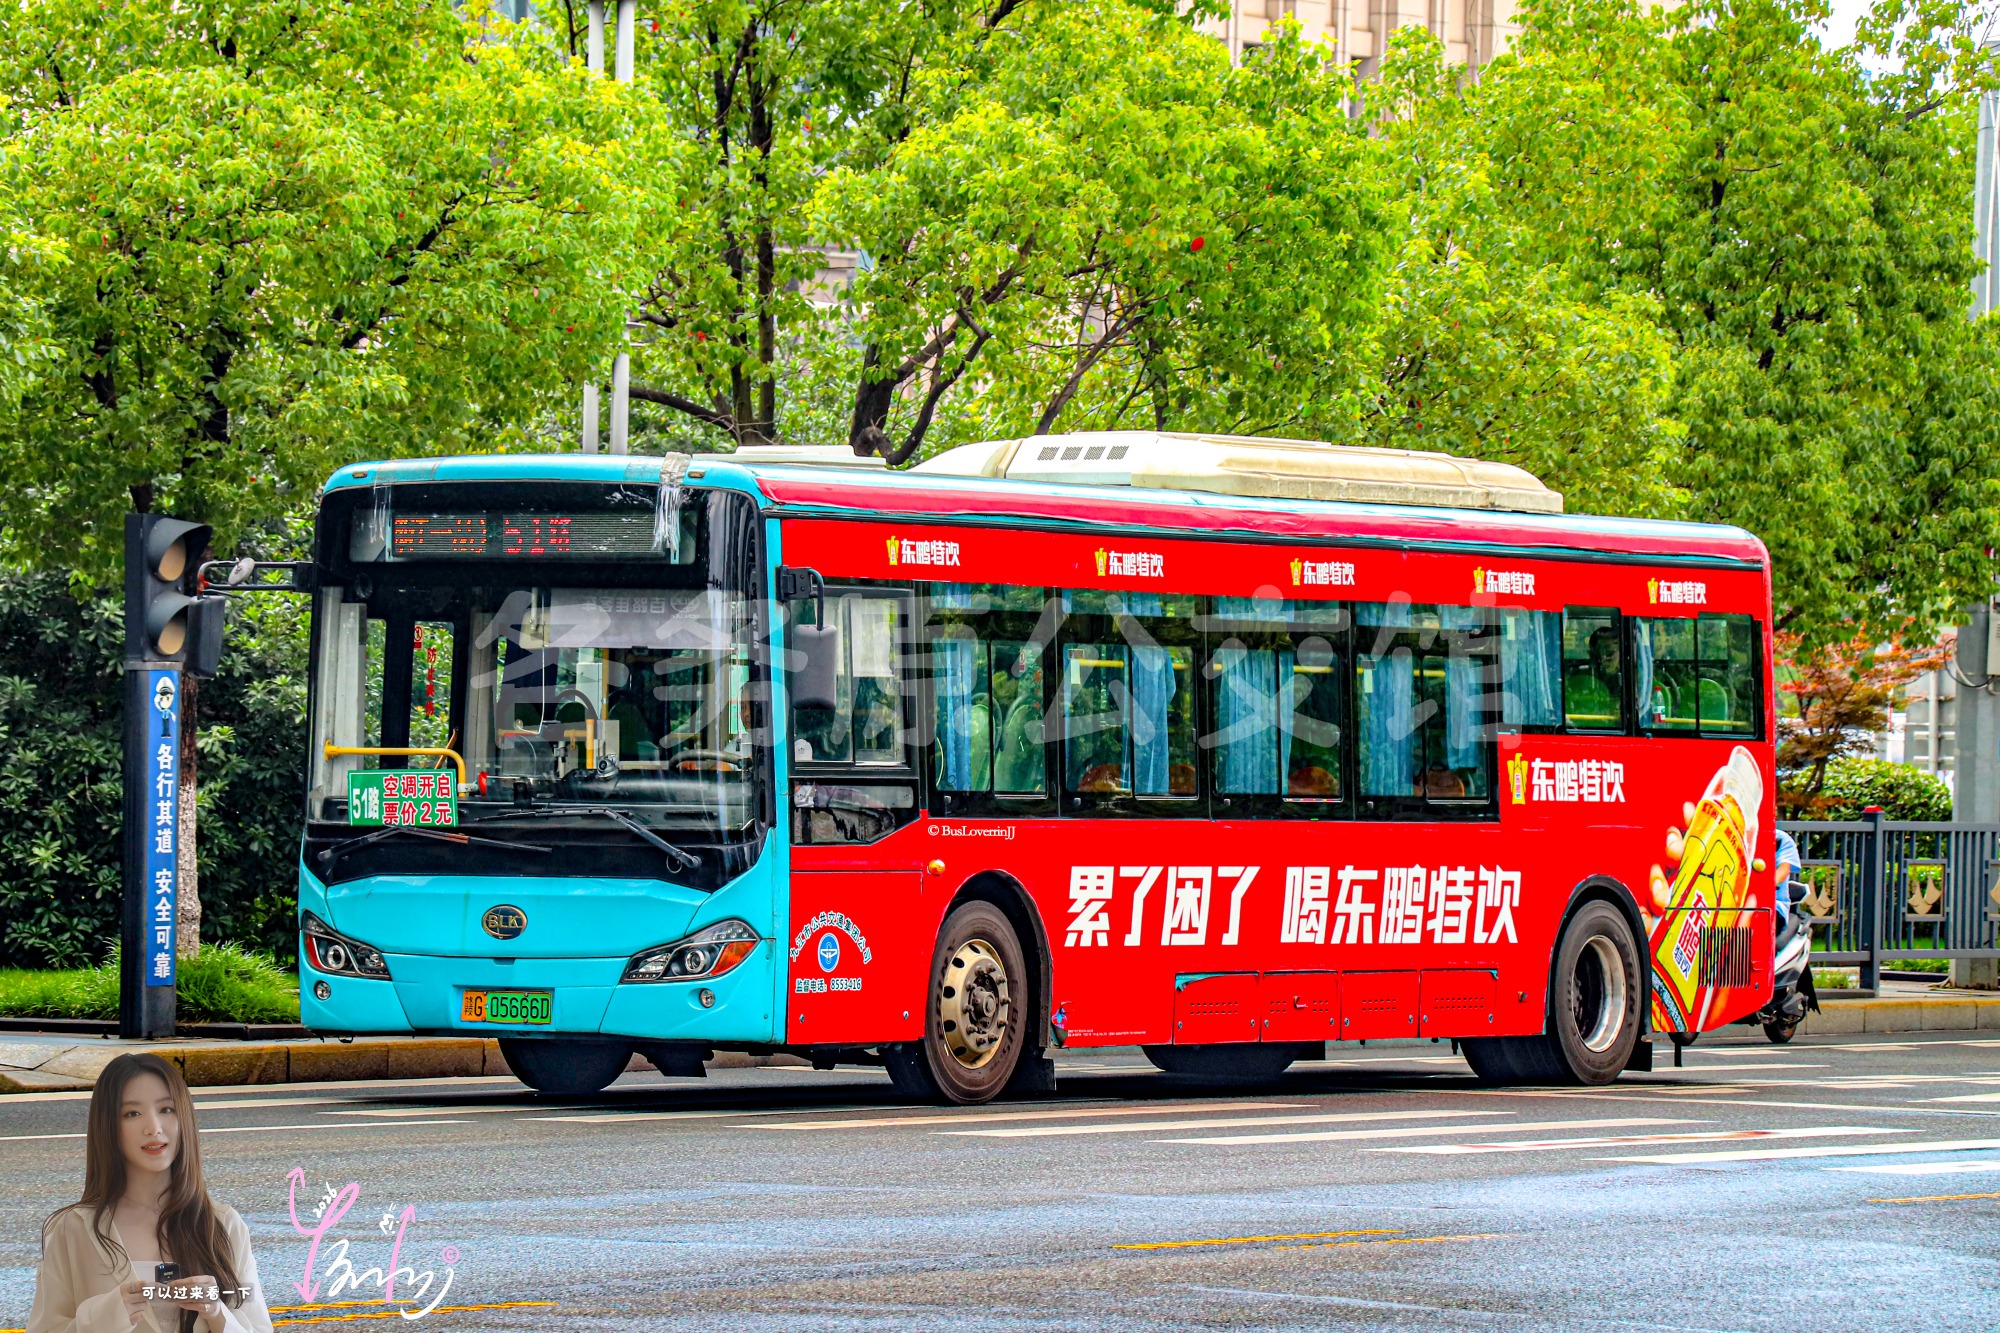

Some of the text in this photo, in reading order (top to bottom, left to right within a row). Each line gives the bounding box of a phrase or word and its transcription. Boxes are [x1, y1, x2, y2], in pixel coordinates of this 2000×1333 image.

[901, 538, 960, 566] 东鹏特饮
[1108, 551, 1164, 578] 东鹏特饮
[1303, 560, 1355, 586] 东鹏特饮
[1486, 569, 1536, 596] 东鹏特饮
[1659, 580, 1707, 604] 东鹏特饮
[383, 775, 451, 798] 空调开启
[1531, 757, 1626, 802] 东鹏特饮
[352, 788, 379, 820] 51路
[383, 802, 452, 825] 票价2元
[154, 743, 174, 979] 各行其道 安全可靠
[1064, 863, 1522, 947] 累了困了 喝东鹏特饮
[487, 914, 521, 929] BLK
[464, 995, 550, 1019] 赣G05666D
